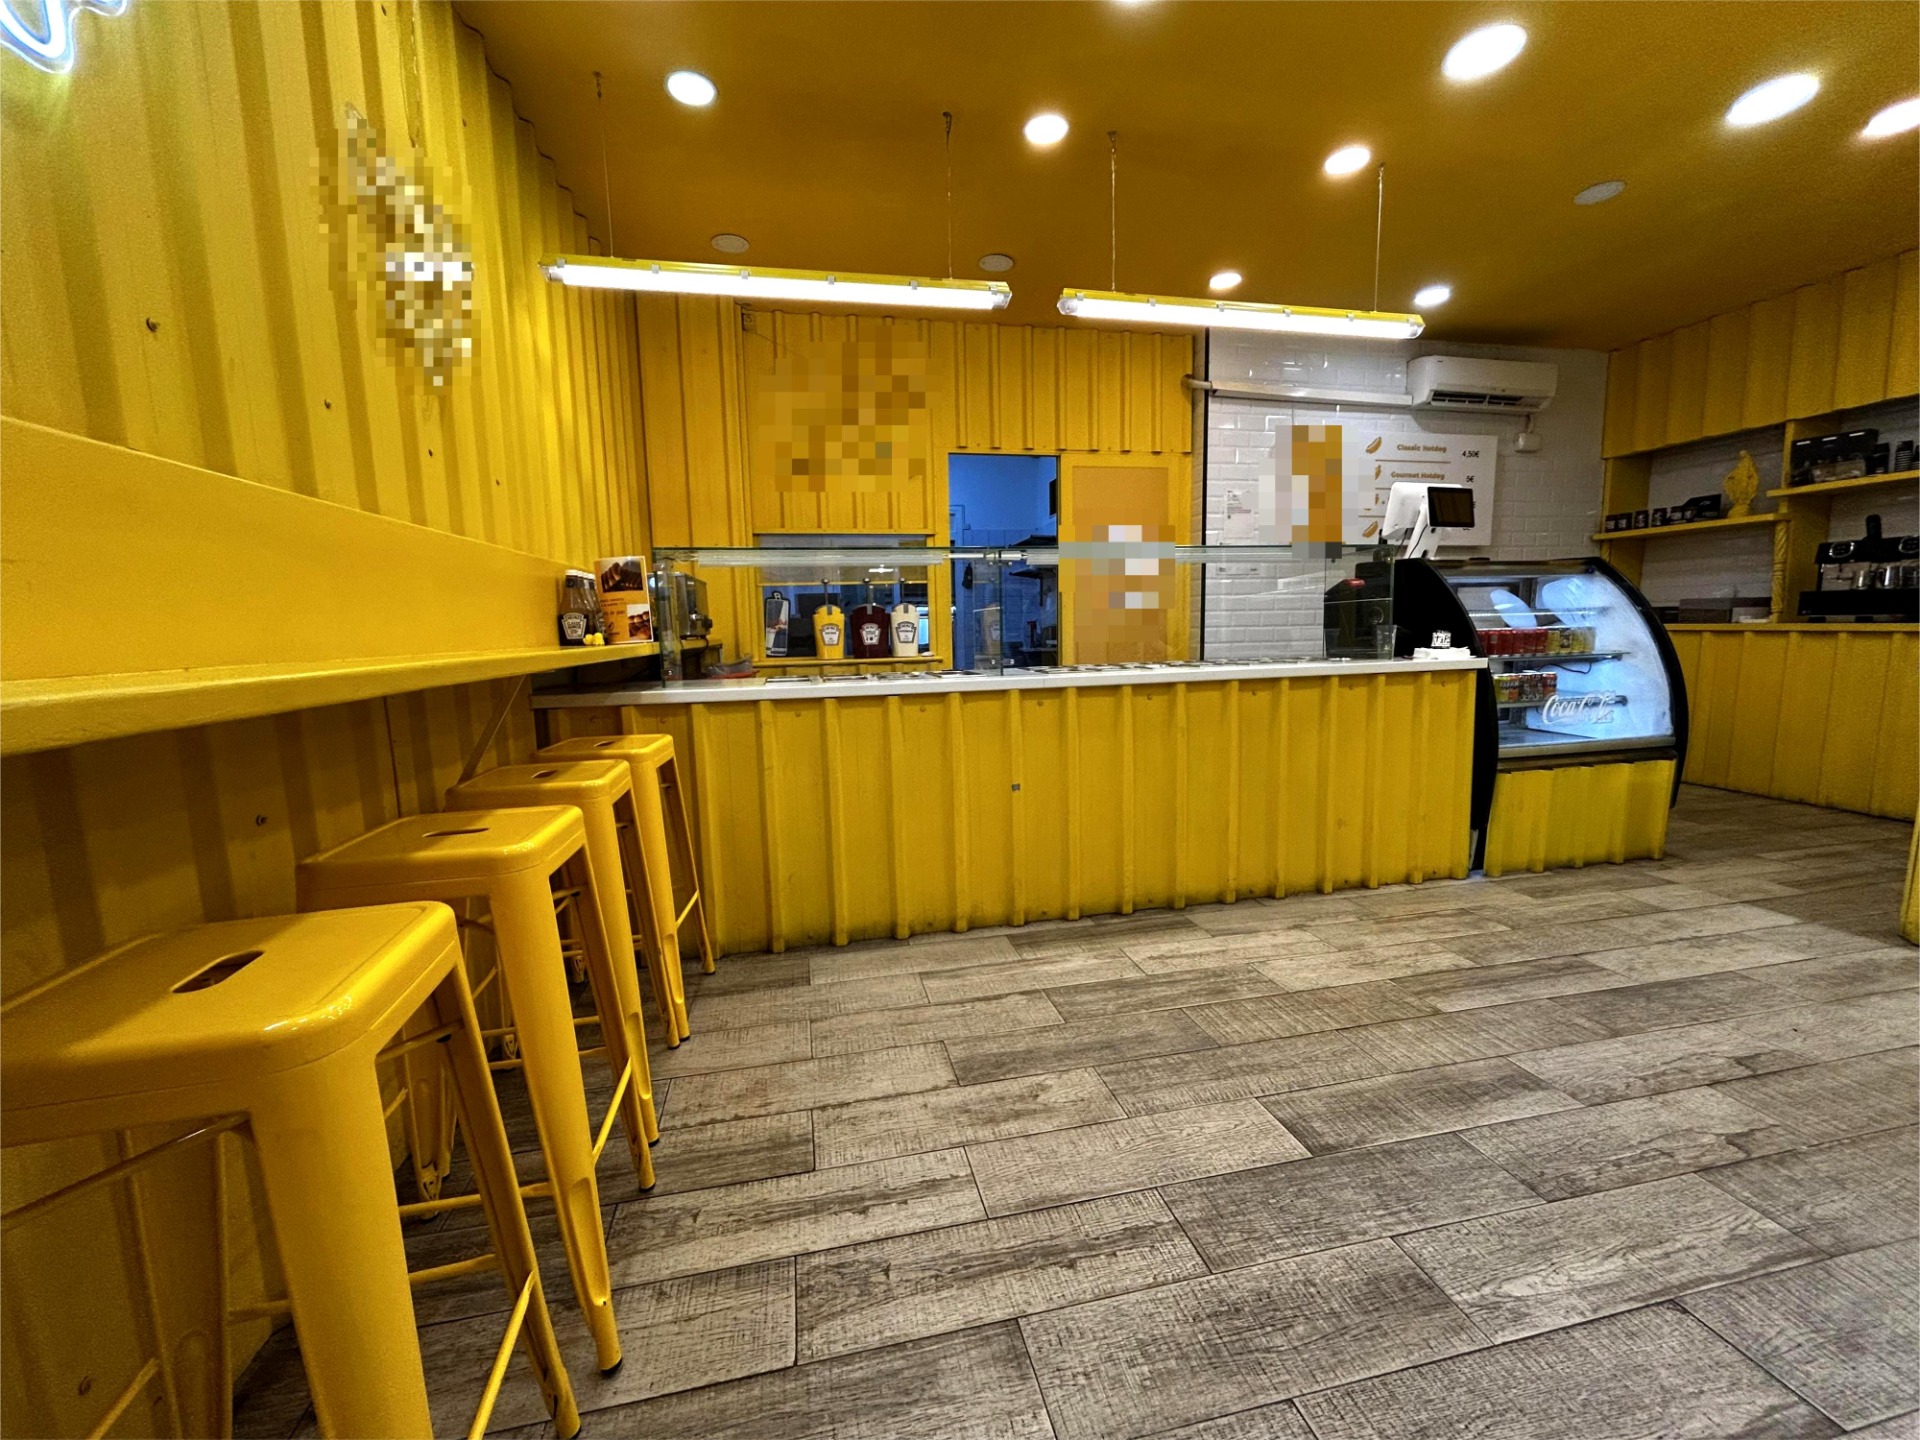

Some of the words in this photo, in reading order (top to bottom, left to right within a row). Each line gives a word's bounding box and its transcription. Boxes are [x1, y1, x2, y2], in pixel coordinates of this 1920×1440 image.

[1397, 443, 1421, 451] Classic
[1423, 445, 1447, 454] Hotdog
[1462, 450, 1480, 458] 4,50€
[1391, 471, 1420, 479] Gourmet
[1421, 472, 1445, 481] Hotdog
[1466, 475, 1475, 483] 5€
